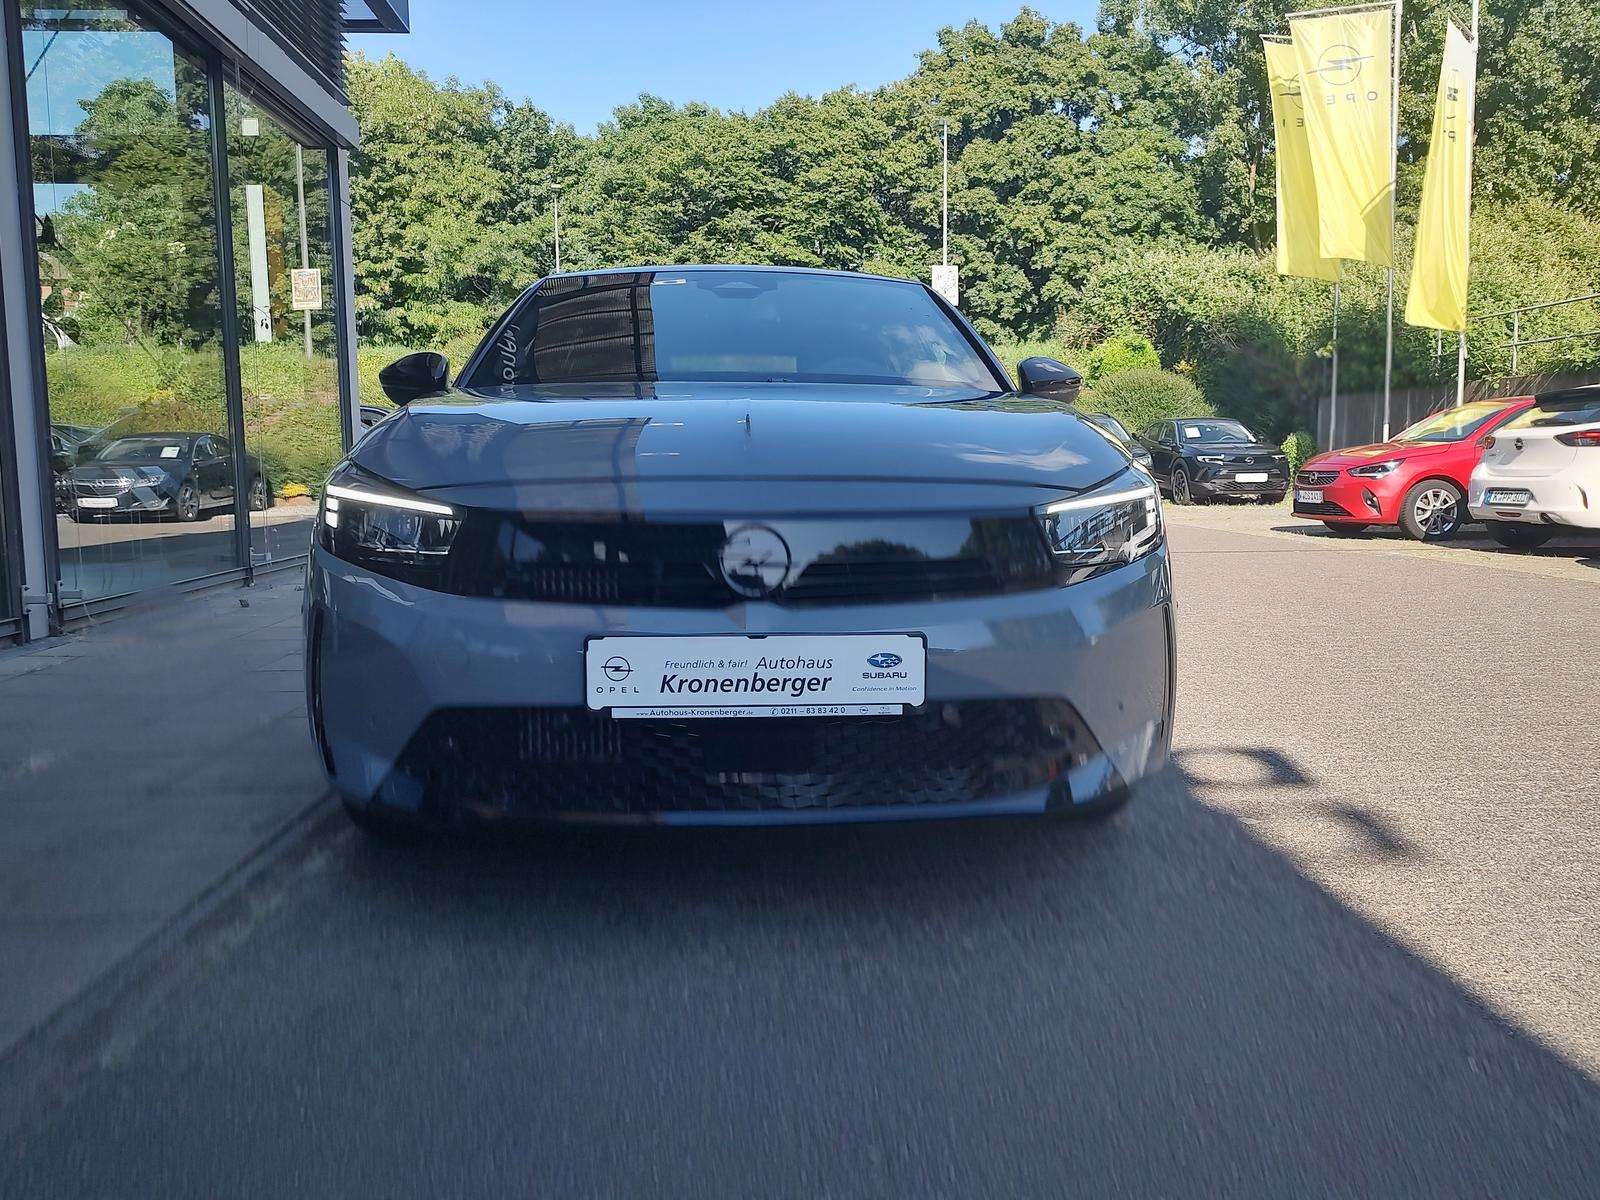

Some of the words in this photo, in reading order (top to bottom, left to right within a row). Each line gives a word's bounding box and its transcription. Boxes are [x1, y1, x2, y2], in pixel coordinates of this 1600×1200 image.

[664, 660, 714, 669] Freundlich
[717, 660, 725, 669] &
[727, 659, 748, 669] fair!
[755, 656, 833, 670] Autohaus
[596, 686, 640, 694] OPEL
[660, 672, 833, 697] Kronenberger
[780, 707, 797, 715] 0211
[840, 706, 846, 714] 0
